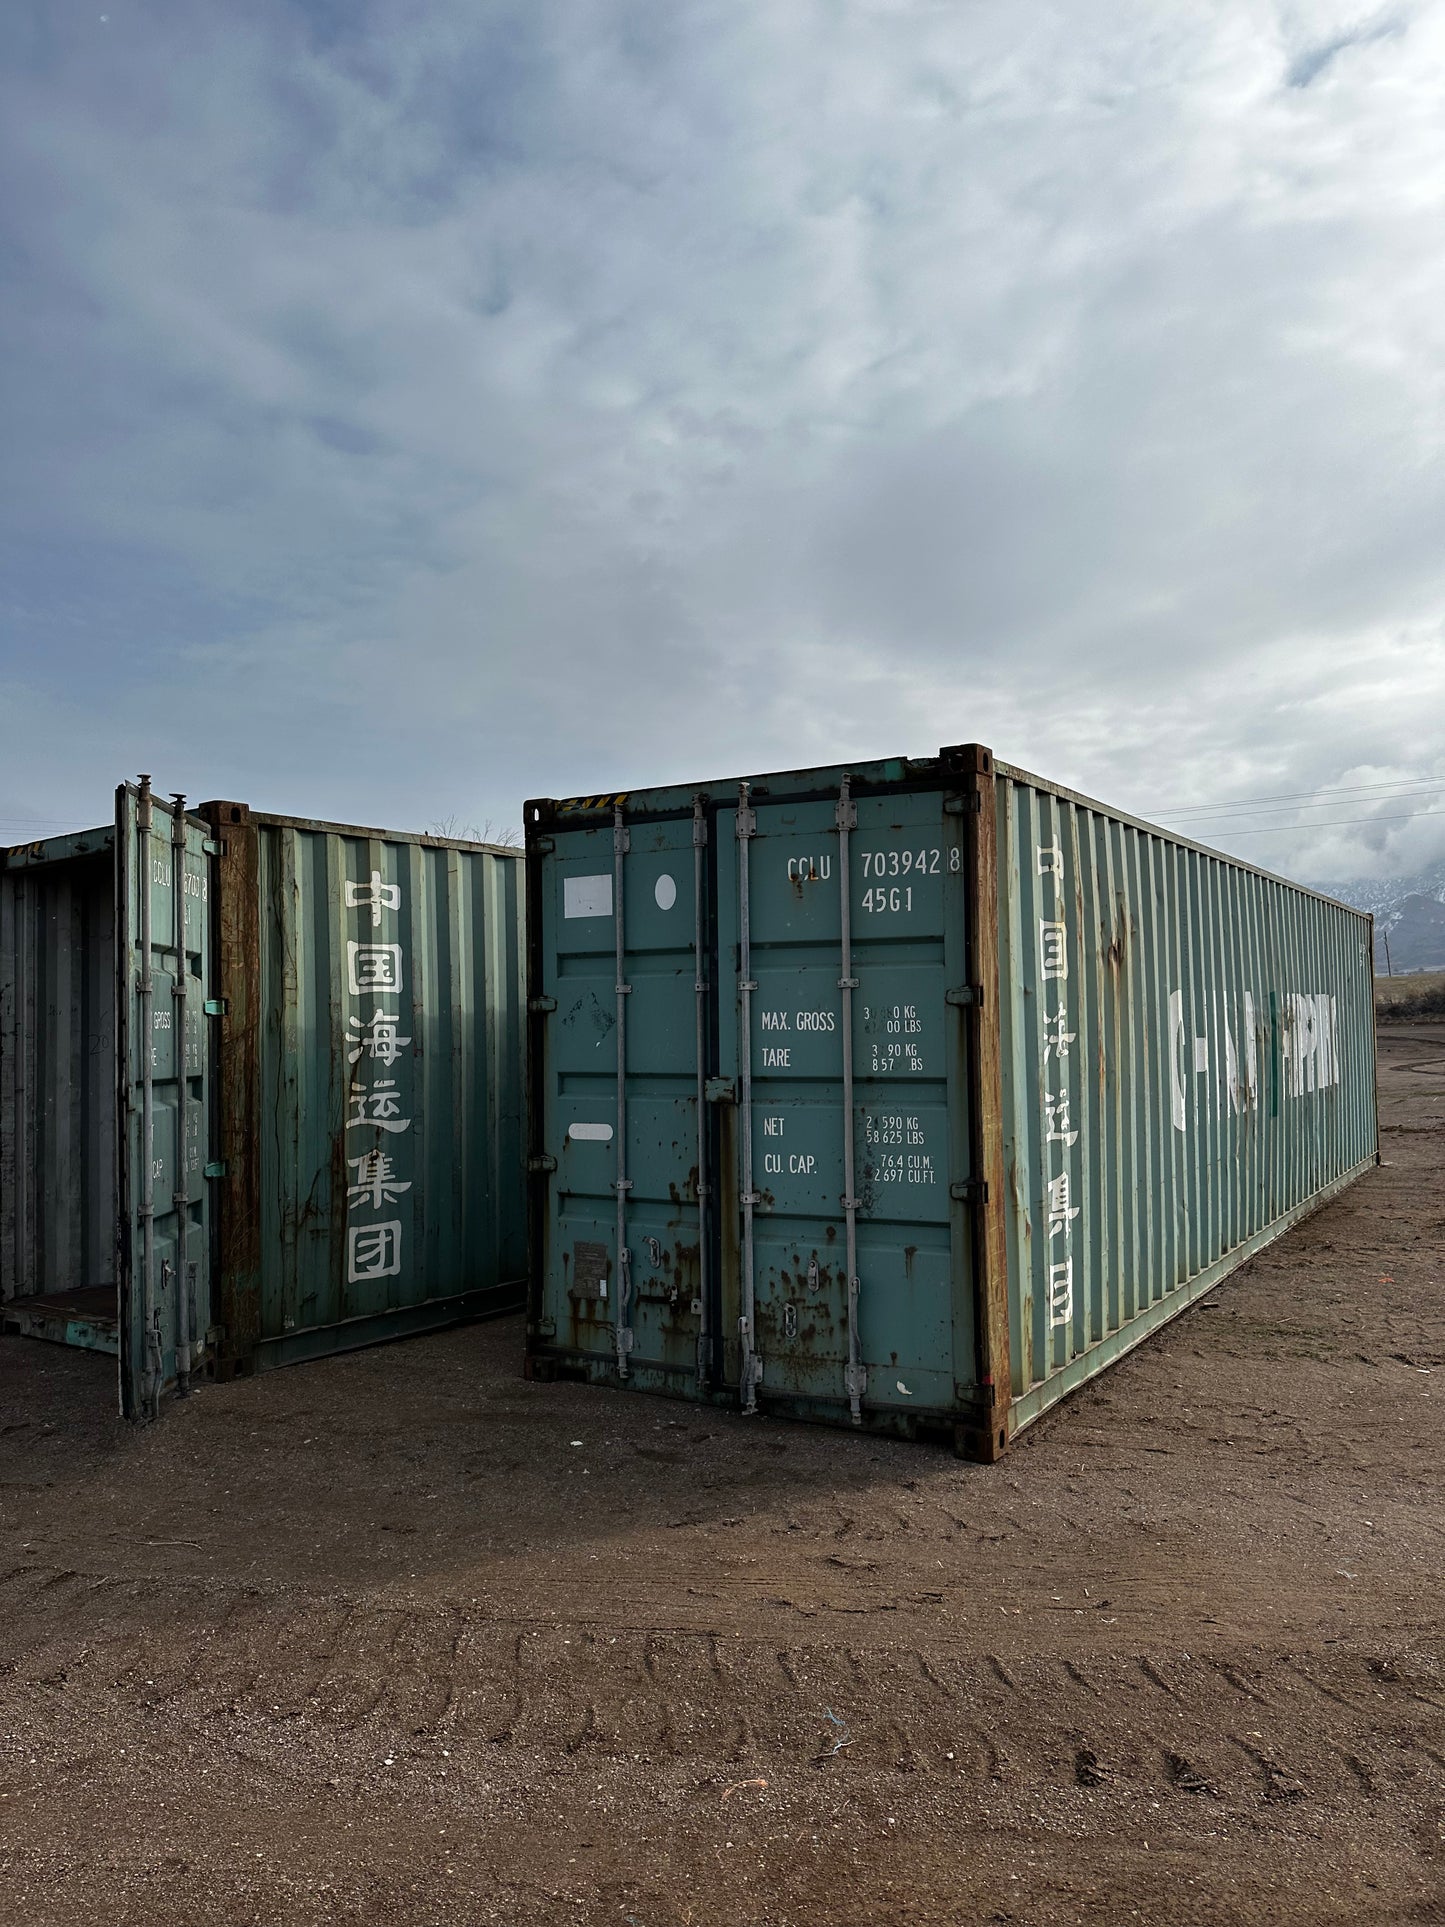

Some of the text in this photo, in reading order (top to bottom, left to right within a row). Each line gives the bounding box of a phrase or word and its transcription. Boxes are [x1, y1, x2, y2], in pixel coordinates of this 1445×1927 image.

[787, 847, 961, 881] CCLU 703942 8
[861, 887, 912, 913] 45G1
[761, 1012, 791, 1031] MAX.
[796, 1012, 835, 1032] GROSS
[904, 1005, 916, 1019] KG
[904, 1020, 922, 1033] LBS
[762, 1048, 791, 1067] TARE
[887, 1044, 901, 1057] 90
[905, 1043, 917, 1057] KG
[909, 1058, 923, 1071] BS
[345, 870, 412, 1284] 中国海运集团
[763, 1117, 785, 1137] NET
[906, 1117, 919, 1130] KG
[907, 1131, 925, 1145] LBS
[764, 1154, 784, 1173] CU.
[789, 1154, 817, 1175] CAP.
[881, 1154, 903, 1168] 76.4
[908, 1170, 936, 1184] CU.FT.
